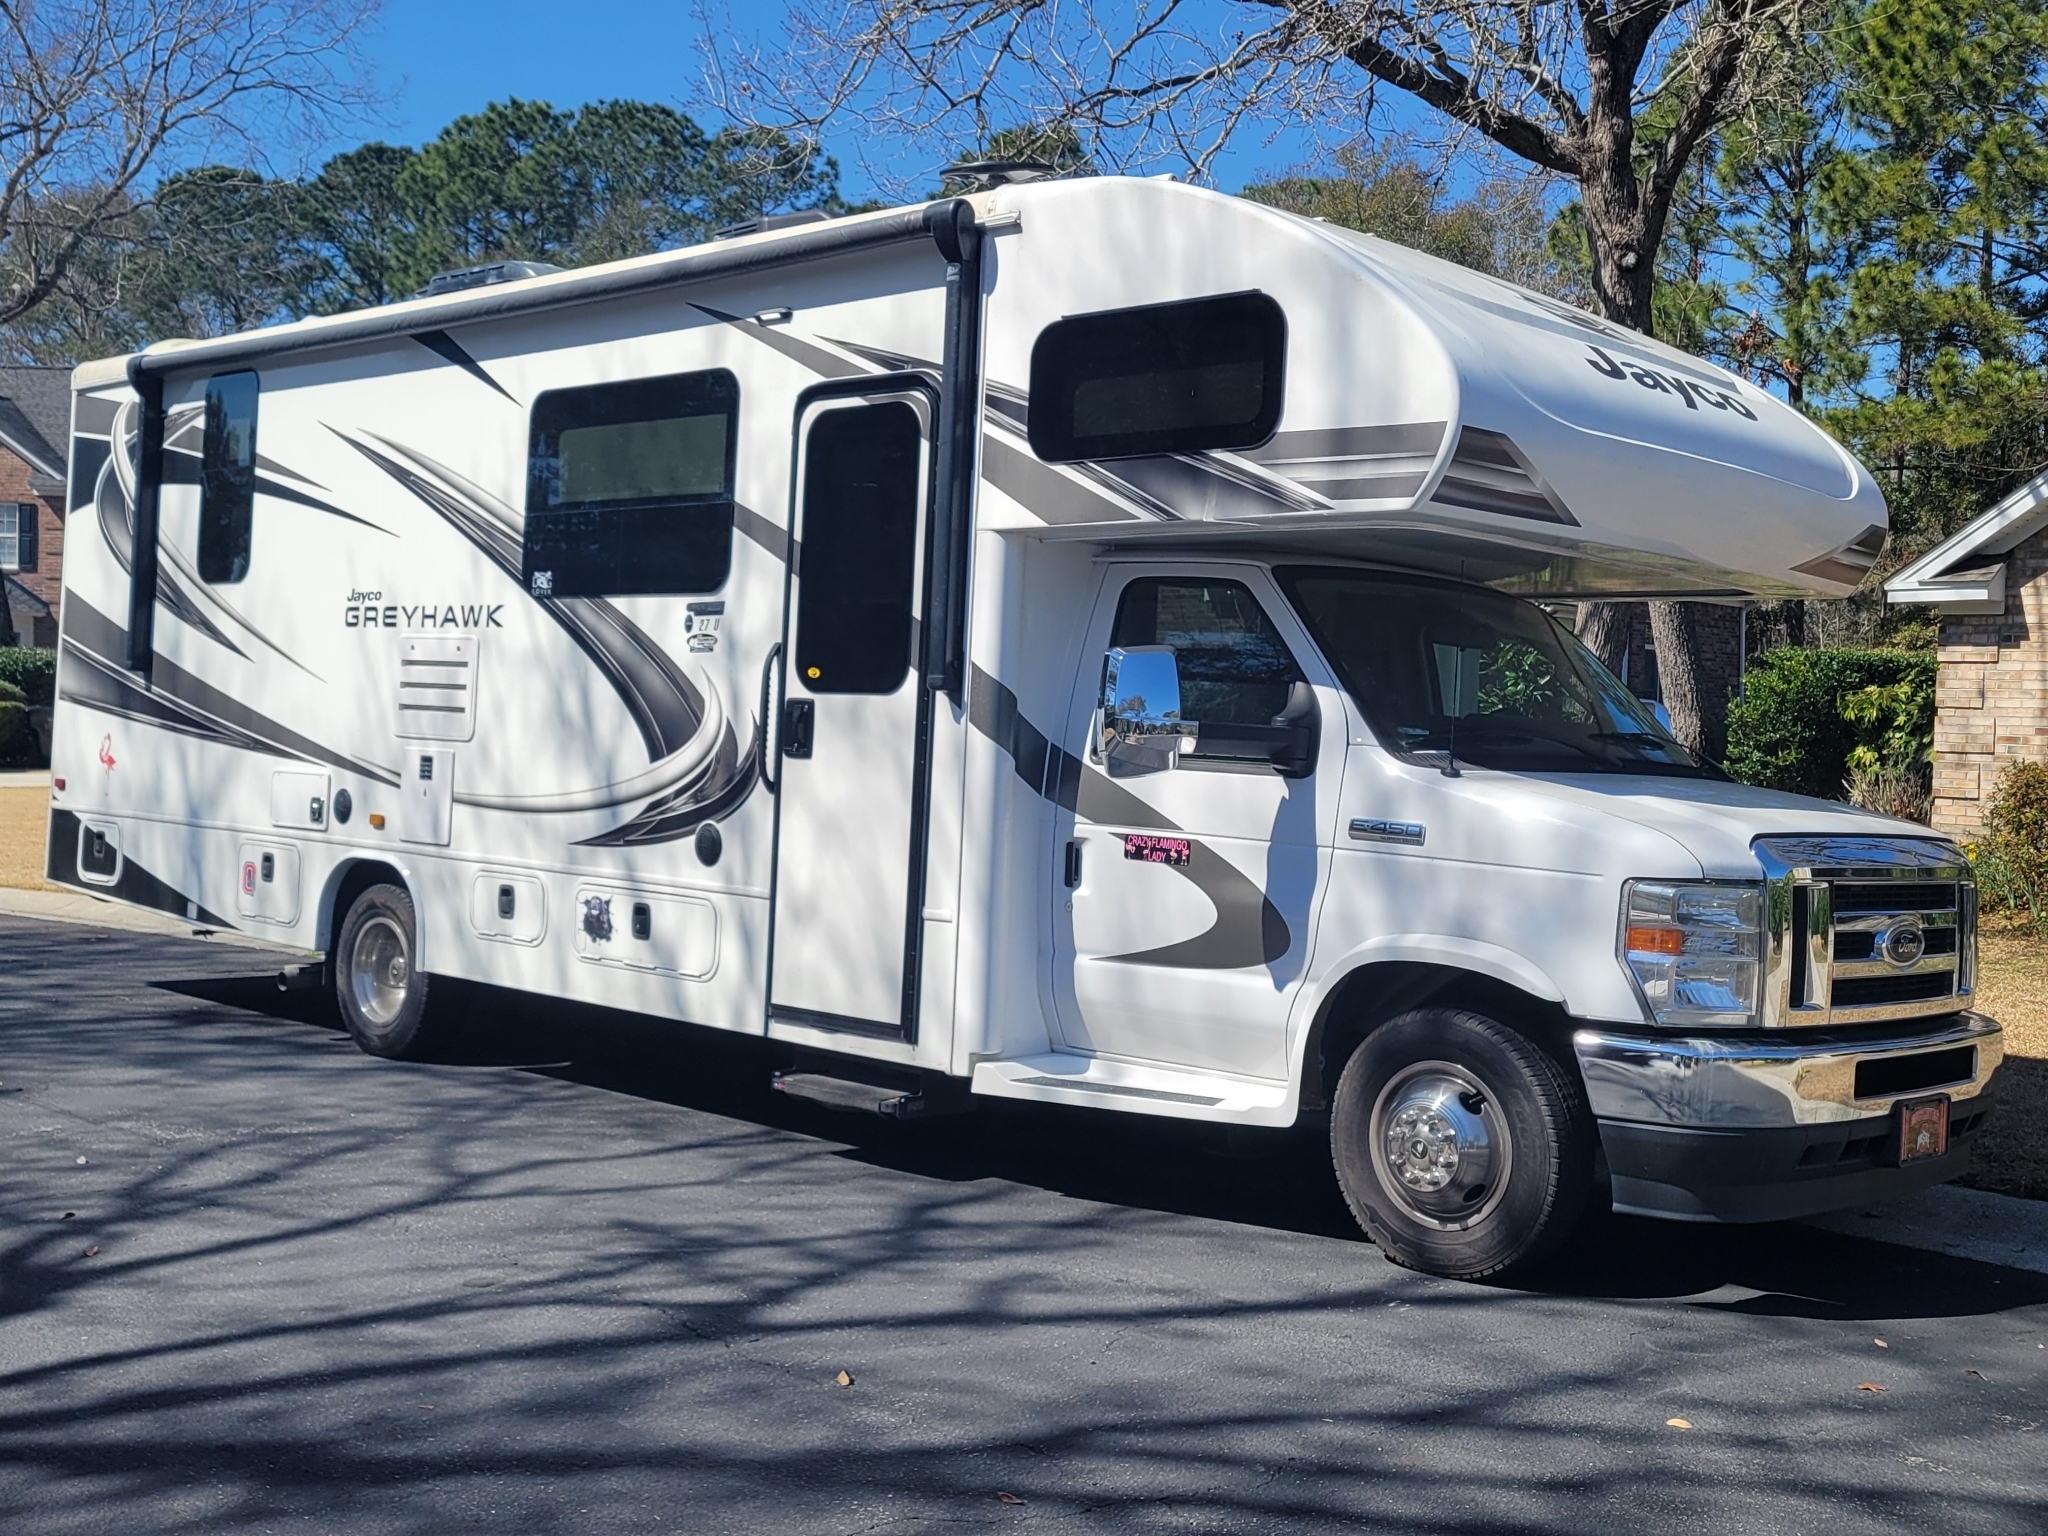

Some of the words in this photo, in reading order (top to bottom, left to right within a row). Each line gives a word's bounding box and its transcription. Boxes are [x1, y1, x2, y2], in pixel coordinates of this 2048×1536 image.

[1584, 344, 1758, 421] Jayco
[347, 589, 382, 604] Jayco
[345, 605, 505, 628] GREYHAWK
[699, 618, 710, 631] 27
[1127, 835, 1151, 847] CRAZY
[1151, 837, 1188, 850] FLAMINGO
[1148, 851, 1167, 862] LADY
[1898, 934, 1918, 953] Ford
